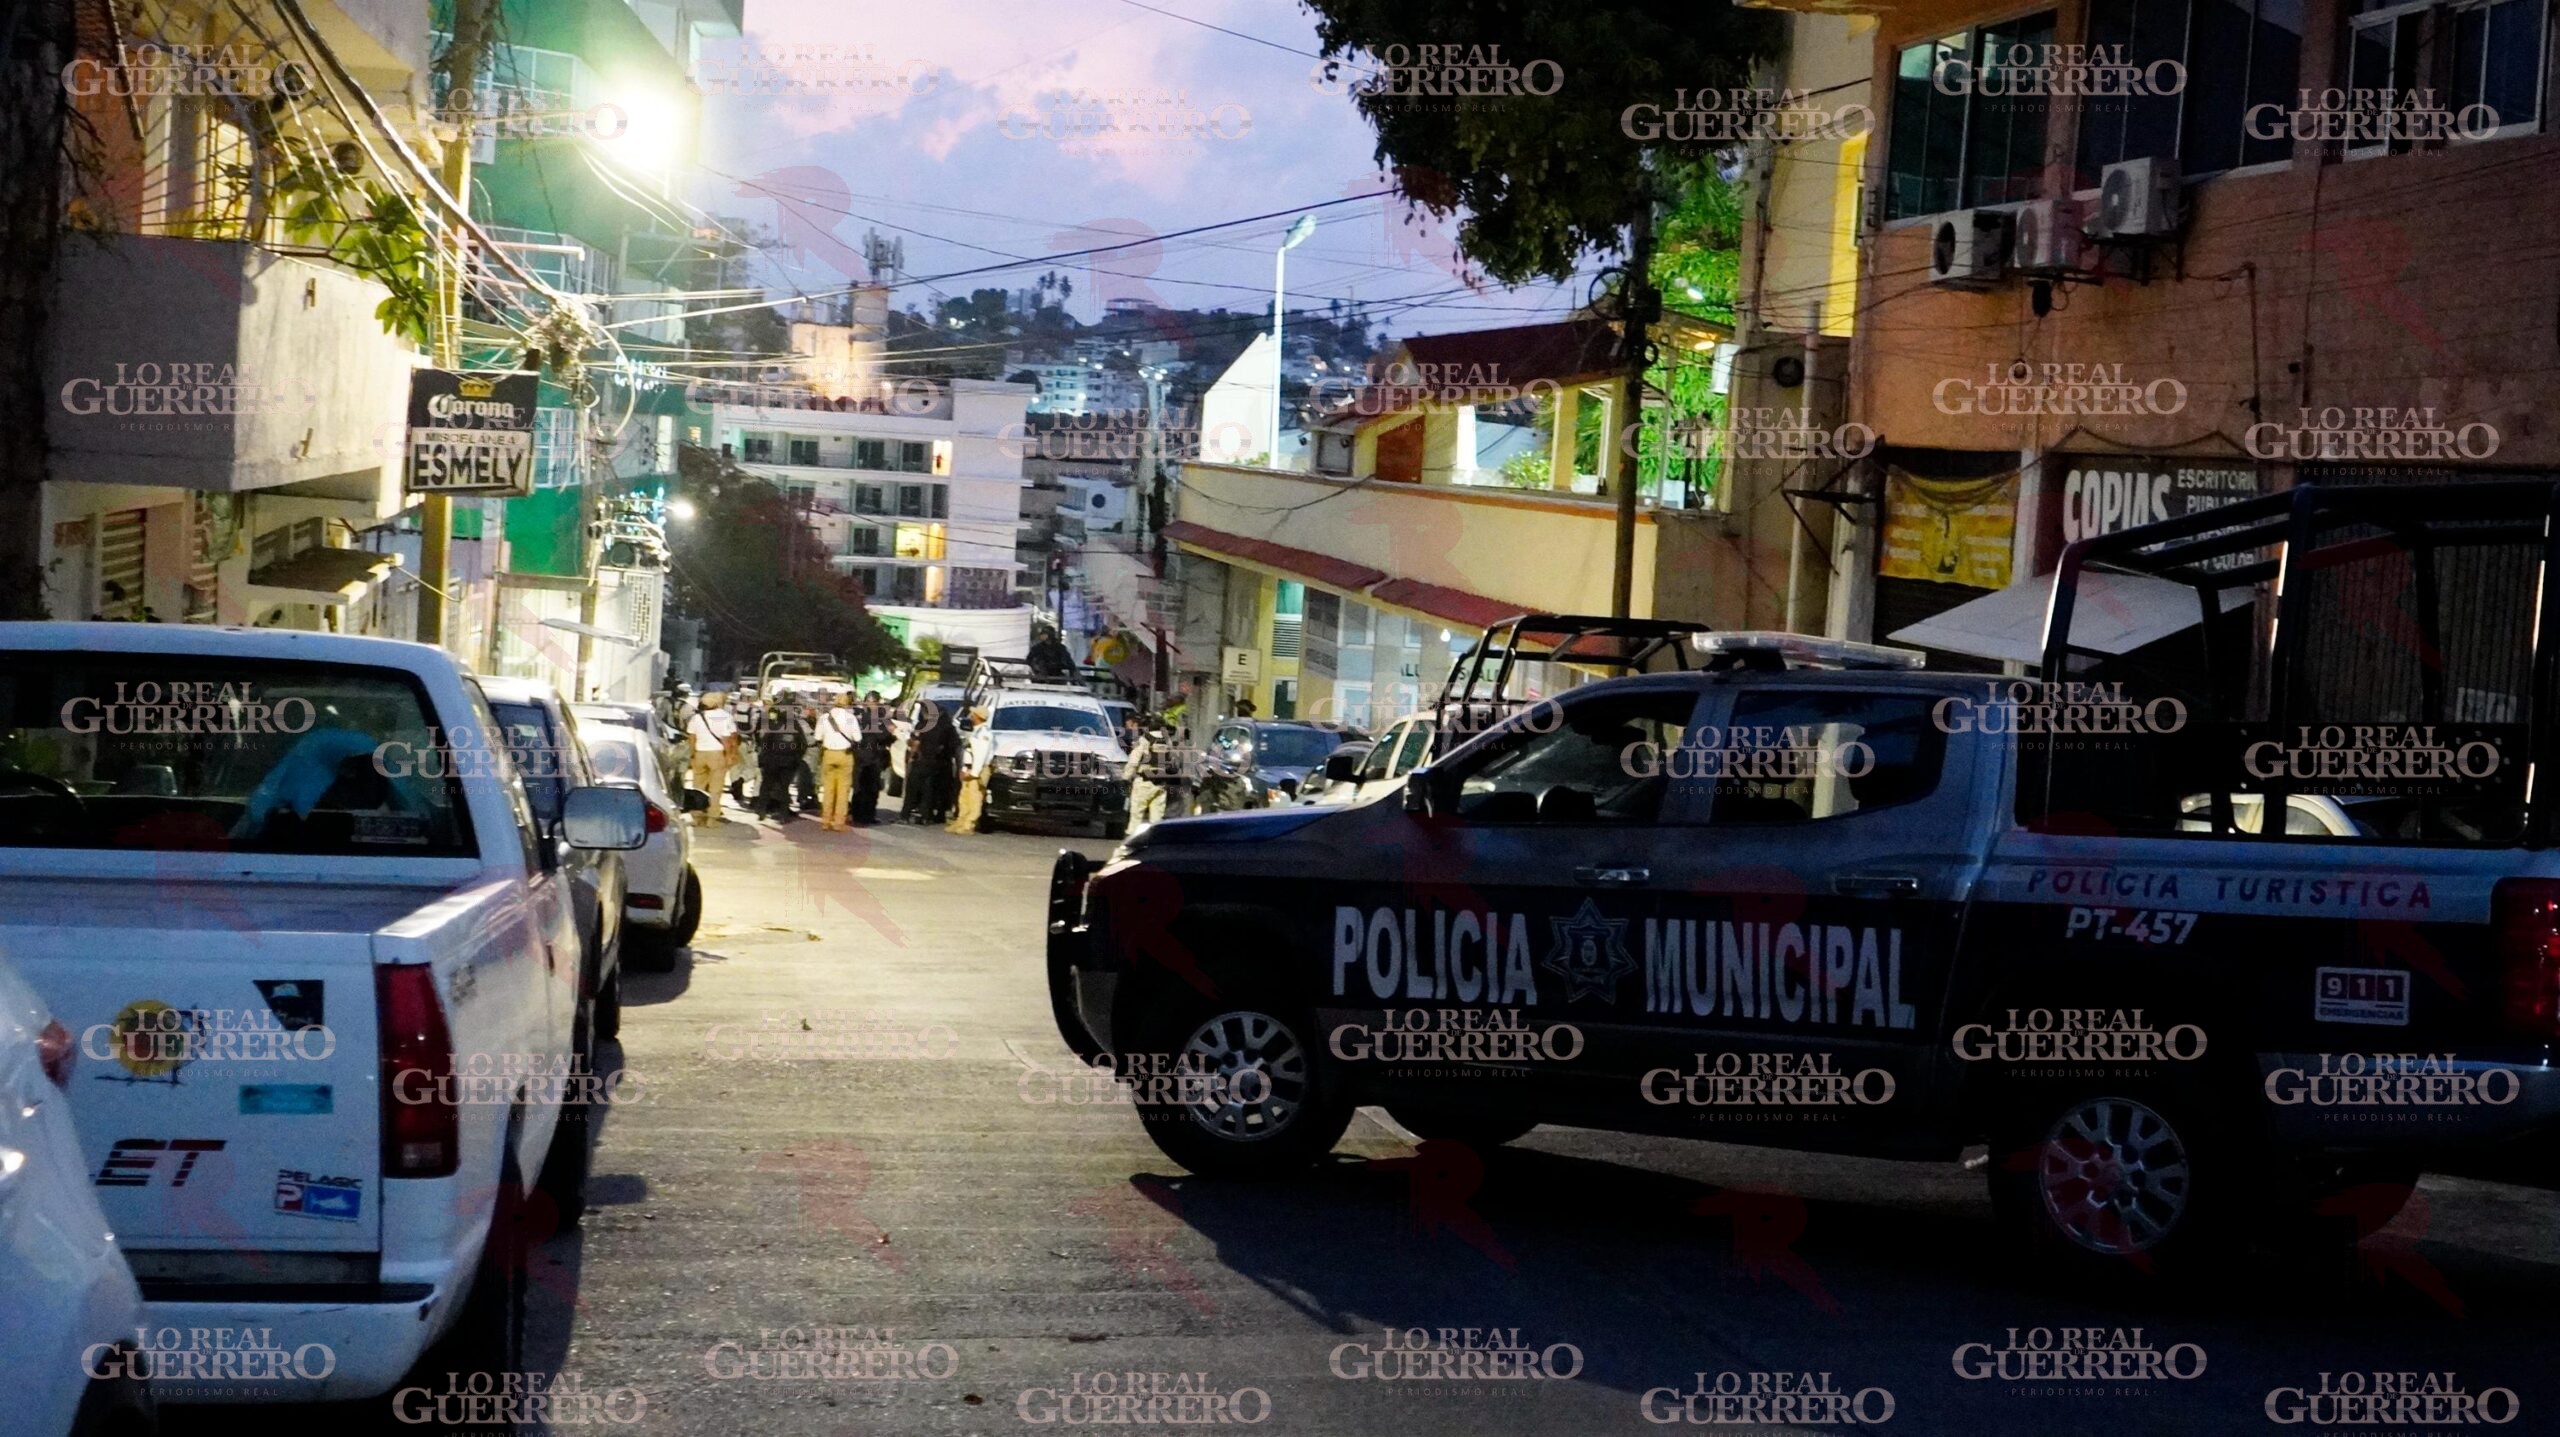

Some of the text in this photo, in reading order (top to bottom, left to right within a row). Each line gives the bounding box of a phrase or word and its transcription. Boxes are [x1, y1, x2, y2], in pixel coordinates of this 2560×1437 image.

[428, 393, 514, 418] Corona
[413, 444, 522, 487] ESMELY
[2063, 469, 2172, 543] COPIAS
[1238, 653, 1247, 666] E
[2027, 869, 2430, 909] POLICIA TURISTICA
[2064, 907, 2198, 945] PT-457
[1333, 905, 1916, 1030] POLICIA MUNICIPAL
[2327, 976, 2395, 998] 911
[90, 1139, 227, 1187] ET
